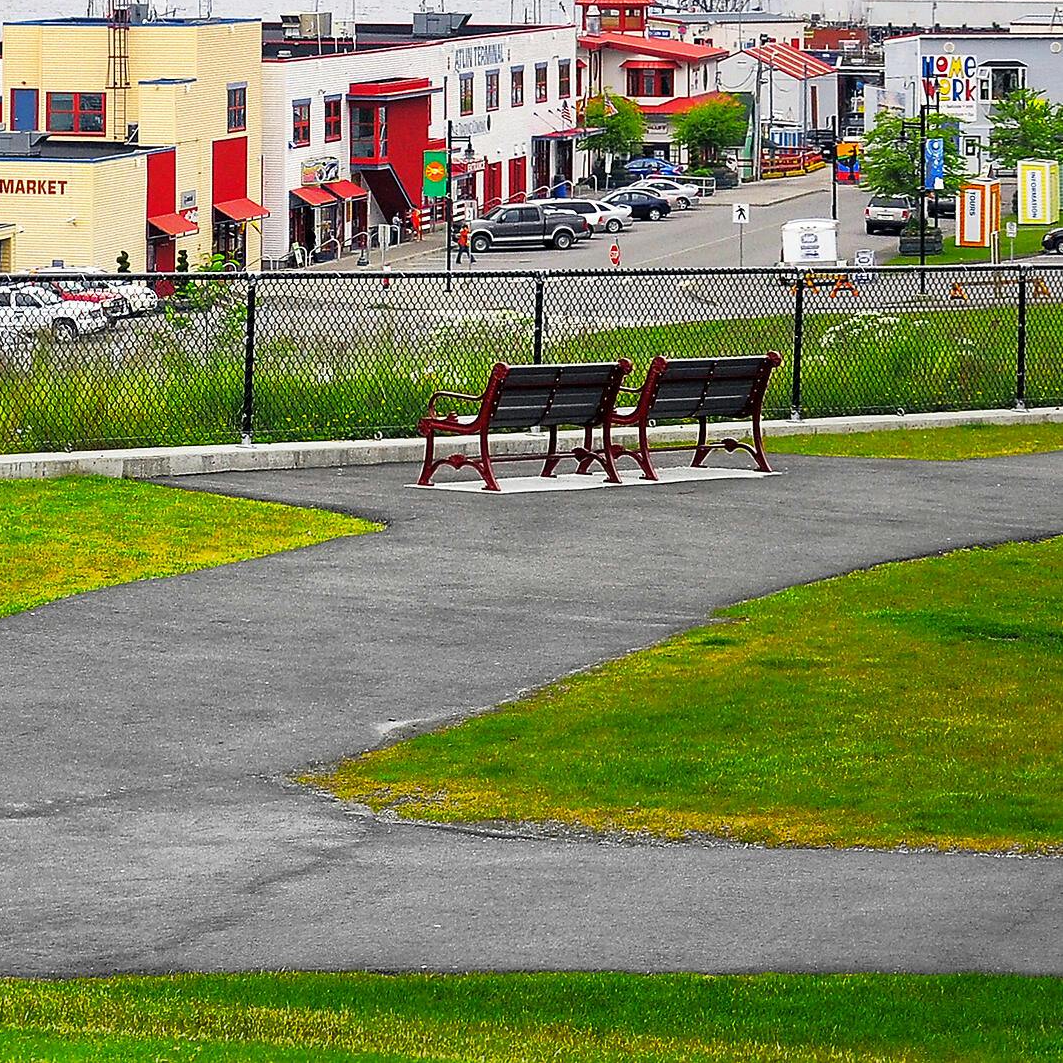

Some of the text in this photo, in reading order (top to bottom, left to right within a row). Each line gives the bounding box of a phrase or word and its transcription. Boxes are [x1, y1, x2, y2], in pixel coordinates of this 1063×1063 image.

[921, 56, 977, 78] HOME
[0, 178, 68, 195] MARKET
[1030, 171, 1039, 218] INFORMATION
